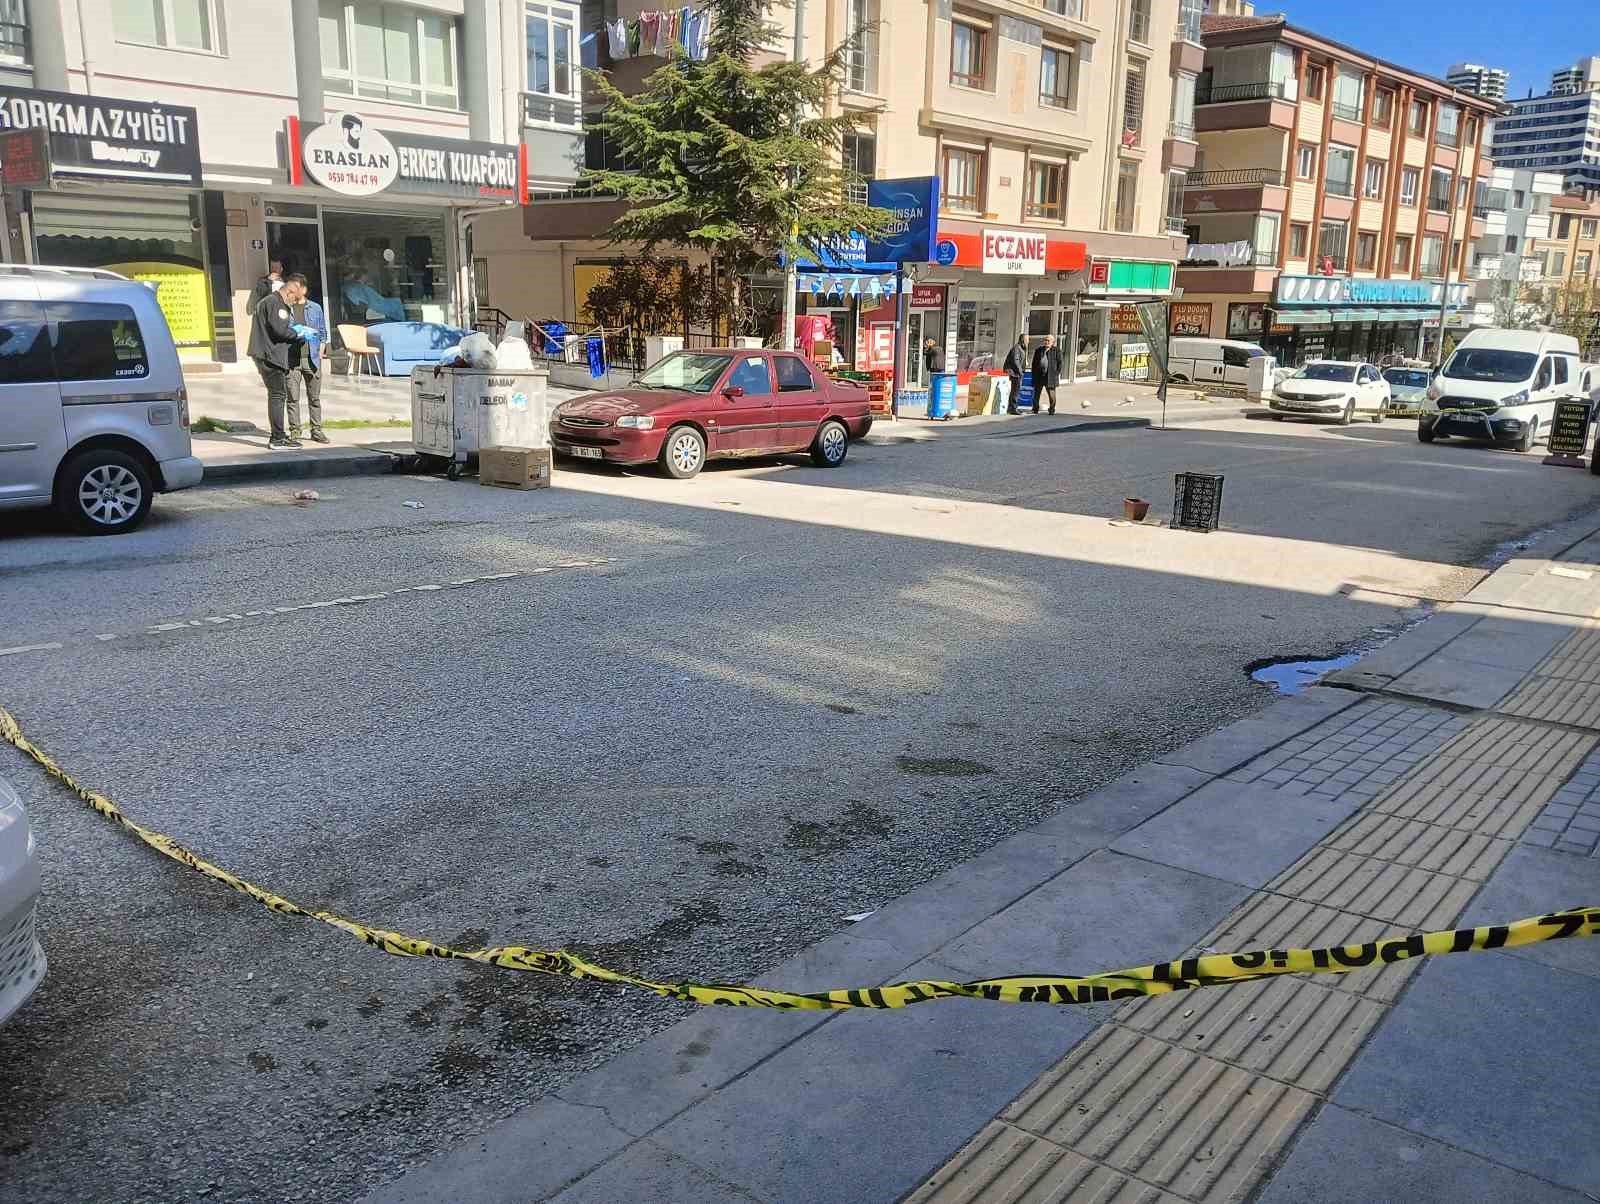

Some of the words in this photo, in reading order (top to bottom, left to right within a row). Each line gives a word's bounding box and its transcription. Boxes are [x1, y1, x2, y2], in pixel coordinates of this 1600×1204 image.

[313, 149, 390, 169] ERASLAN
[399, 147, 448, 180] ERKEK
[449, 150, 516, 186] KUAFÖRÜ
[887, 222, 910, 233] GIDA
[985, 235, 1045, 260] ECZANE
[1007, 262, 1023, 270] UFUK
[487, 378, 516, 387] MAMAK
